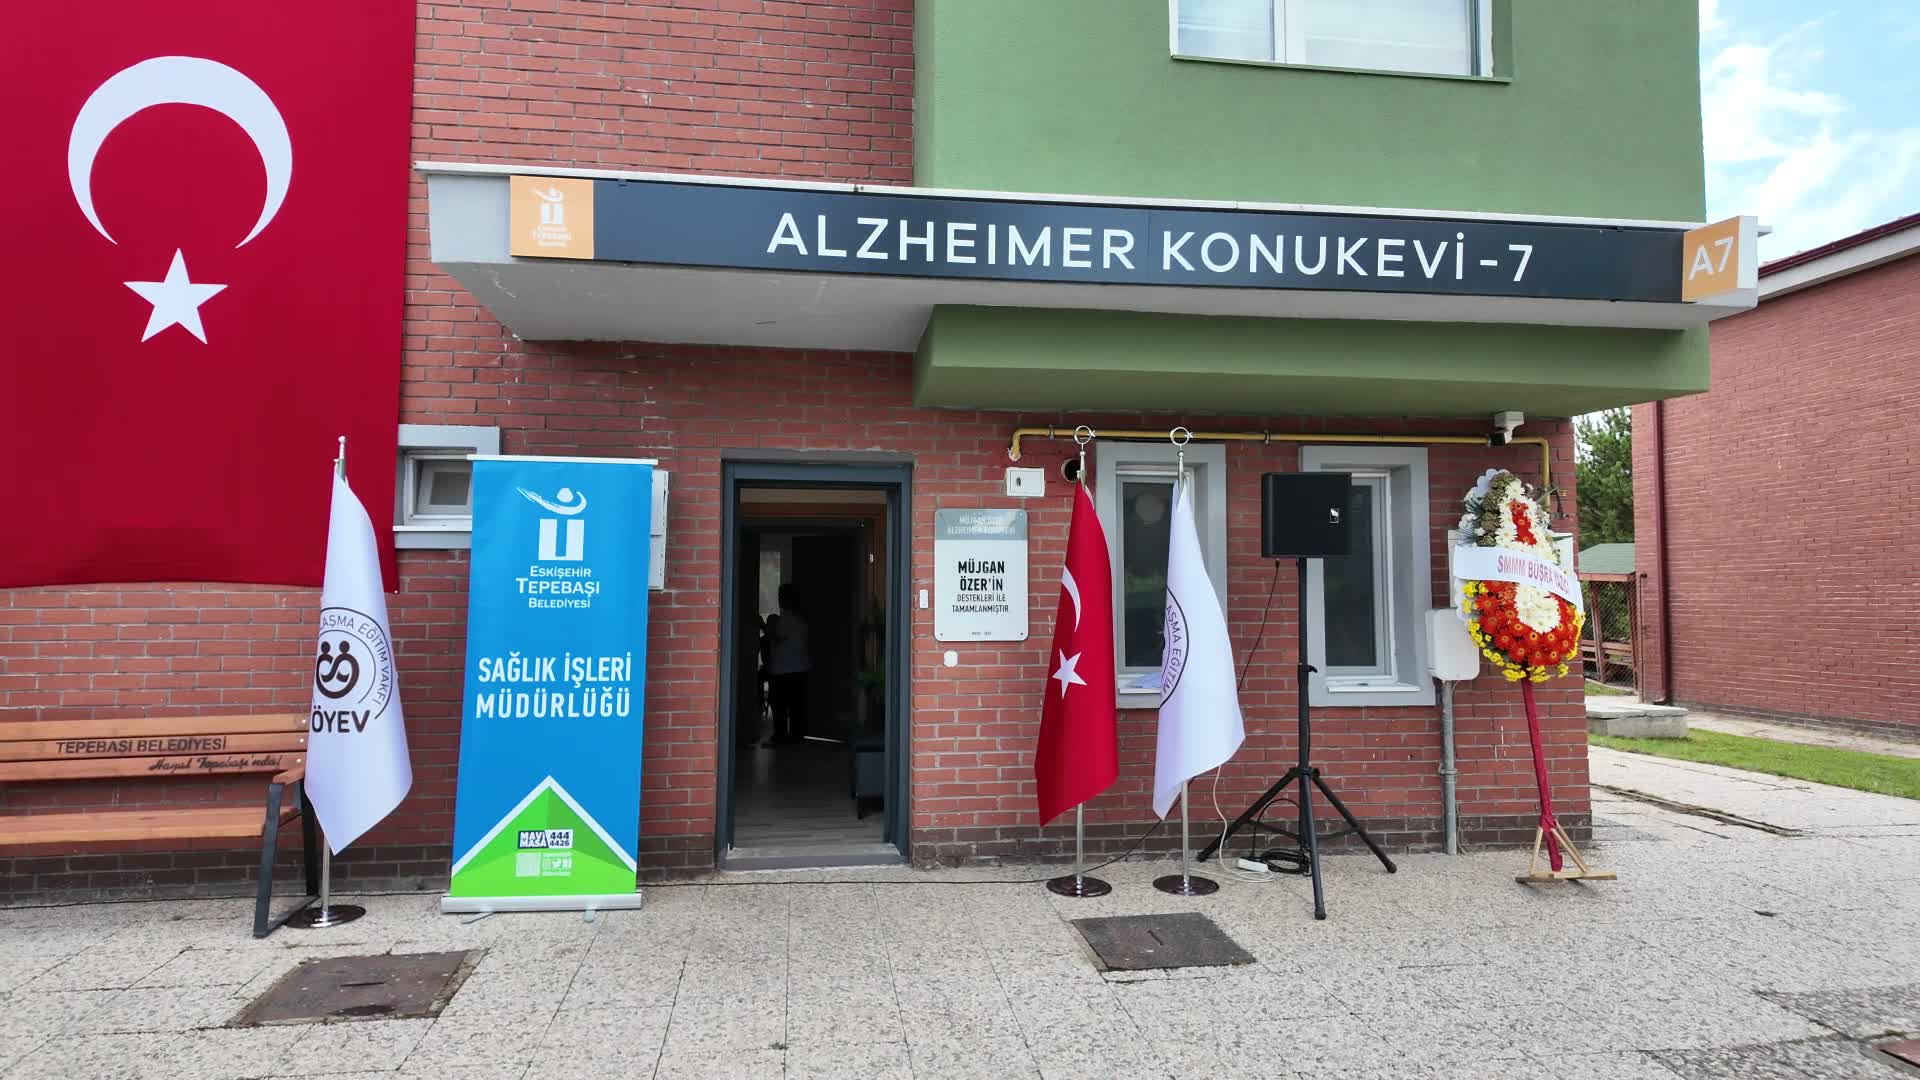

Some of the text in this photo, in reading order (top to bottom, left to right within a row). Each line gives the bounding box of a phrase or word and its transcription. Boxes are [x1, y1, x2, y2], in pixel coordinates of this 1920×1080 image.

[767, 212, 1135, 270] ALZHEIMER
[1688, 235, 1734, 281] A7
[530, 565, 592, 579] ESKİŞEHİR
[958, 558, 1005, 574] MÜJGAN
[1497, 555, 1526, 577] SMMM
[516, 577, 600, 598] TEPEBAŞI
[960, 575, 1003, 591] ÖZER'İN
[528, 597, 591, 609] BELEDİYESİ
[957, 593, 994, 602] DESTEKLERİ
[952, 604, 1009, 615] TAMAMLANMIŞTIR
[478, 651, 632, 688] SAĞLIK İŞLERİ
[475, 686, 631, 719] MÜDÜRLÜĞÜ
[311, 705, 371, 733] ÖYEV
[550, 831, 570, 840] 444
[520, 840, 547, 848] MASA
